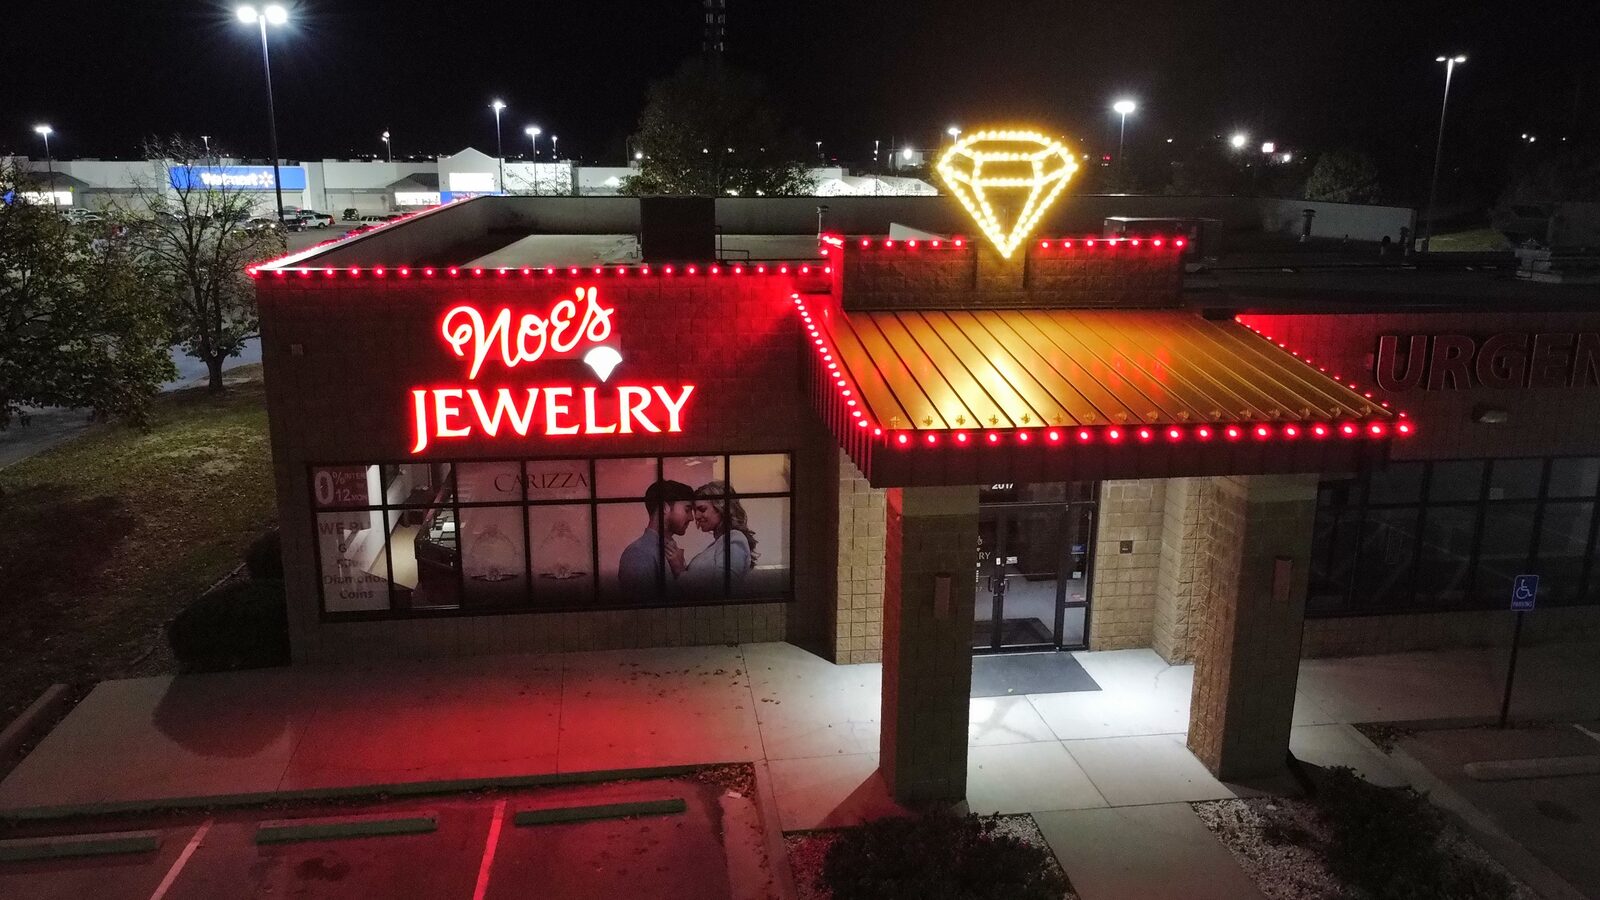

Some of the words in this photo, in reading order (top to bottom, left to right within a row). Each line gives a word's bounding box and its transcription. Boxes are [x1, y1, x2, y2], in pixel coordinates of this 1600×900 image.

[410, 385, 695, 454] JEWELRY
[494, 472, 588, 492] CARIZZA
[335, 488, 351, 501] 12
[319, 521, 345, 535] WE
[339, 590, 375, 600] Coins
